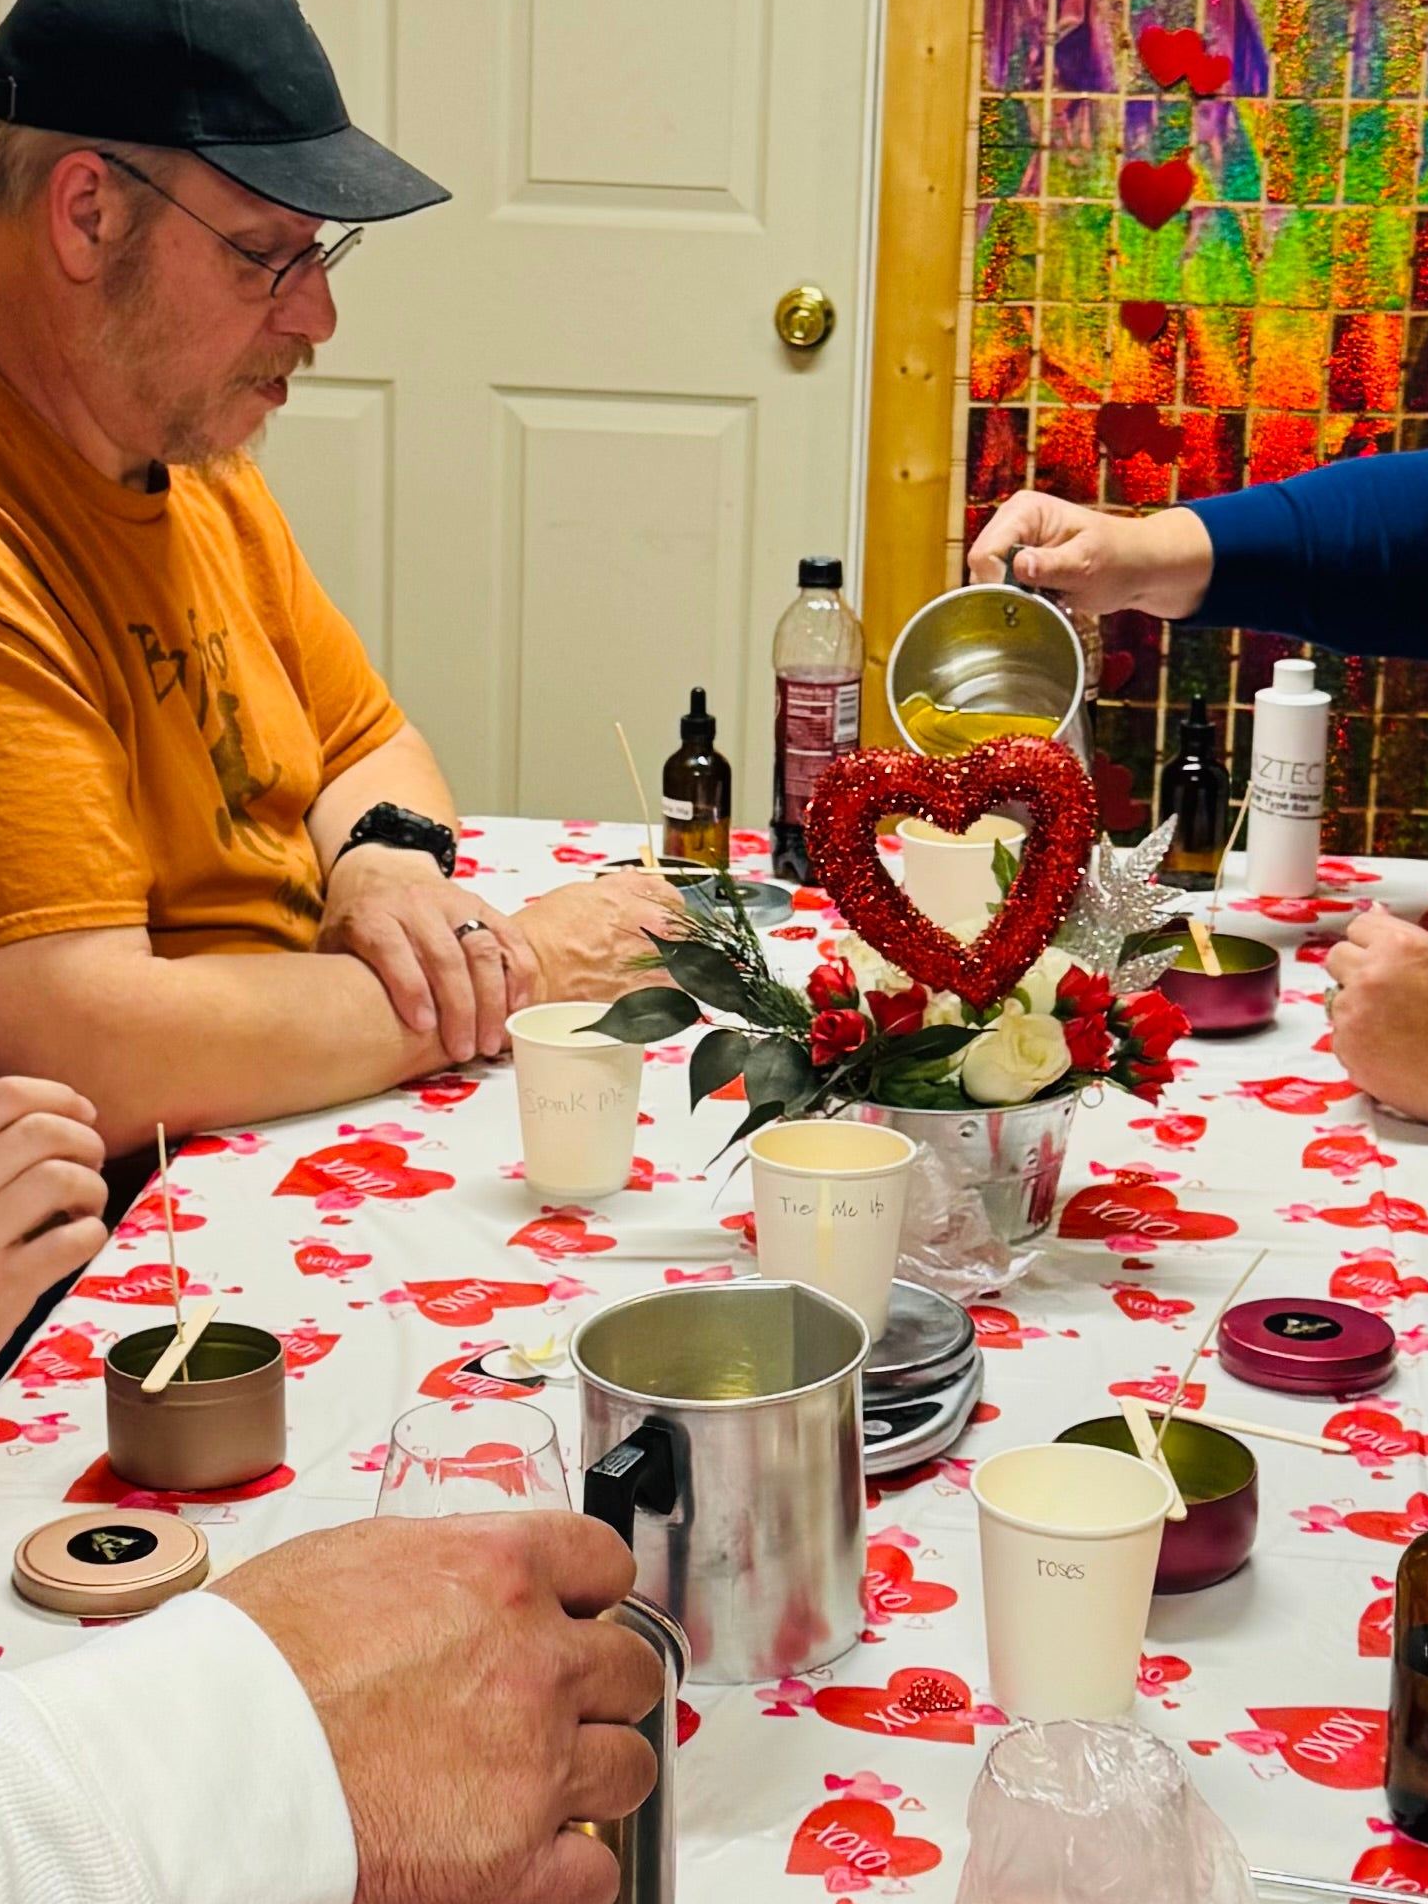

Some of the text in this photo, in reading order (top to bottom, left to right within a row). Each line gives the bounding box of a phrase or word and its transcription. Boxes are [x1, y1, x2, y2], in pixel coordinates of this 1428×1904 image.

[1255, 755, 1321, 785] ZTEC
[779, 1196, 814, 1215] Tie
[832, 1200, 859, 1217] Me
[1078, 1199, 1180, 1236] XOXO
[529, 1226, 582, 1252] XOXO
[99, 1275, 175, 1303] XOXO
[1126, 1298, 1174, 1315] XOXO
[1338, 1423, 1408, 1454] XOXO
[1037, 1557, 1086, 1580] roses
[807, 1822, 890, 1869] XOXO
